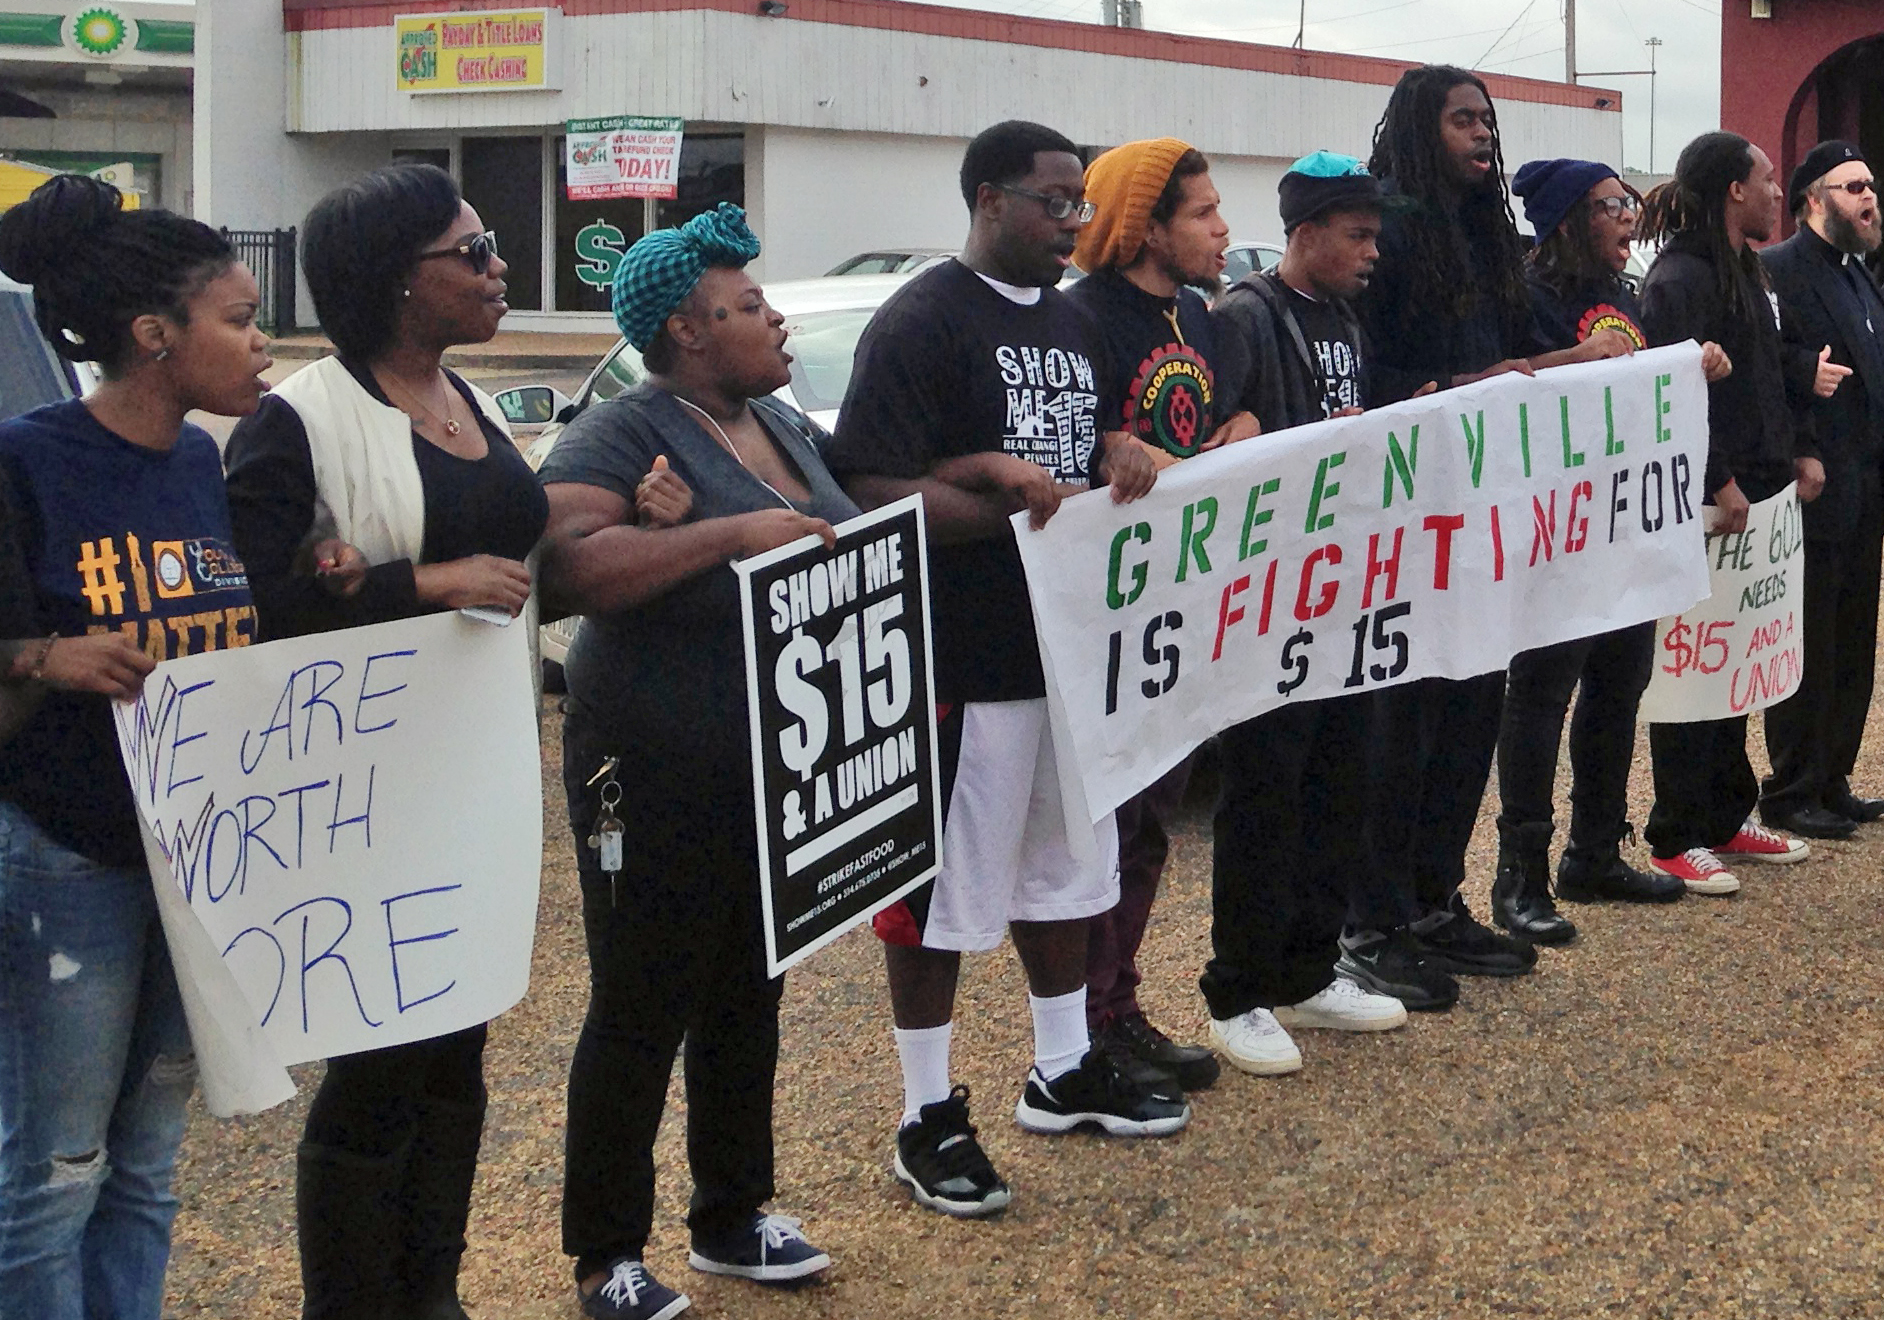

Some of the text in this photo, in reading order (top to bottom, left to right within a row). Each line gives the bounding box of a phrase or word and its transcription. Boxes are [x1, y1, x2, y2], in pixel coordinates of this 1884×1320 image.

[401, 48, 438, 80] CASH
[442, 20, 475, 49] PAYDAY
[485, 18, 511, 47] TITLE
[512, 16, 543, 46] LOANS
[457, 52, 527, 84] CHECK CASHING
[573, 147, 607, 164] CASH
[995, 345, 1094, 391] SHOW
[1142, 361, 1211, 410] COOPERATION
[1003, 439, 1058, 451] REAL CHANGE
[1106, 373, 1672, 610] GREENVILLE
[769, 532, 904, 635] SHOW ME
[1105, 452, 1694, 716] IS FIGHTING FOR
[1738, 569, 1787, 613] NEEDS
[1661, 610, 1794, 678] $15 AND A
[1728, 638, 1802, 713] UNION
[774, 593, 912, 783] $15
[115, 649, 418, 806] WE ARE
[782, 725, 917, 841] & A UNION
[151, 764, 376, 904] WORTH
[816, 838, 895, 895] #STRIKEFASTFOOD
[222, 884, 462, 1033] ORE
